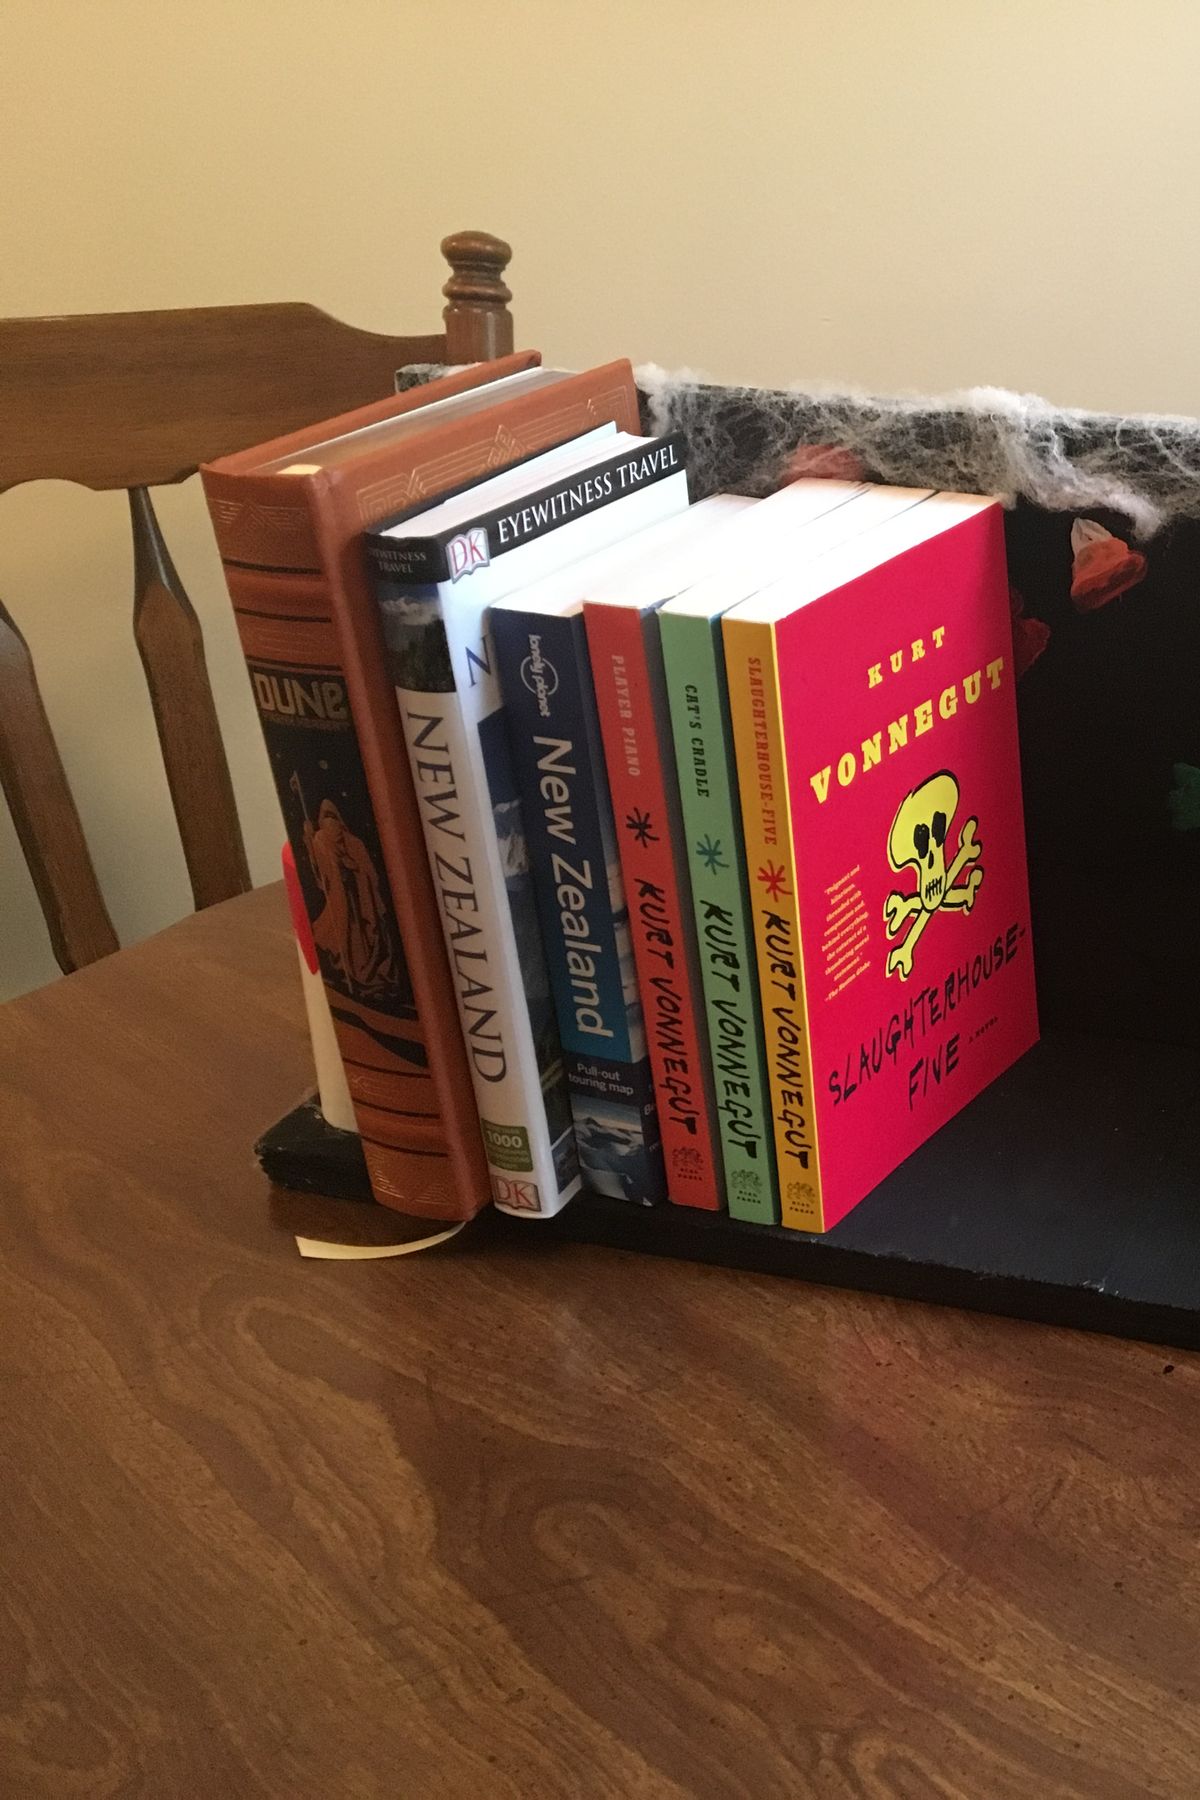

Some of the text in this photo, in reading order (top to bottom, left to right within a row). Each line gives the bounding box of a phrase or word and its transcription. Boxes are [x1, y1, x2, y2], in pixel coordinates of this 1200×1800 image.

[498, 444, 678, 544] EYEWITNESS TRAVEL
[450, 530, 485, 575] DK
[528, 633, 552, 718] lonely planet
[867, 626, 946, 689] KURT
[612, 654, 641, 777] PLAYER PIANO
[685, 683, 710, 798] CAT'S CRADLE
[748, 656, 778, 847] SLAUGHTERHOUSE-FIVE
[809, 656, 1005, 805] VONNEGUT
[406, 710, 467, 843] NEW
[532, 735, 615, 1039] New Zealand
[634, 878, 674, 970] KURT
[434, 851, 508, 1084] ZEALAND
[700, 900, 741, 993] KURT
[761, 909, 798, 1002] KURT
[649, 976, 697, 1136] VONNEGUT
[828, 922, 1025, 1107] SLAUGHTERHOUSE-
[568, 1072, 635, 1097] touring map
[576, 1062, 621, 1082] Pull-out
[711, 998, 762, 1160] VONNEGUT
[772, 1006, 812, 1170] VONNEGUT
[908, 1032, 961, 1113] FIVE
[485, 1130, 523, 1149] 1000
[494, 1175, 536, 1208] DK
